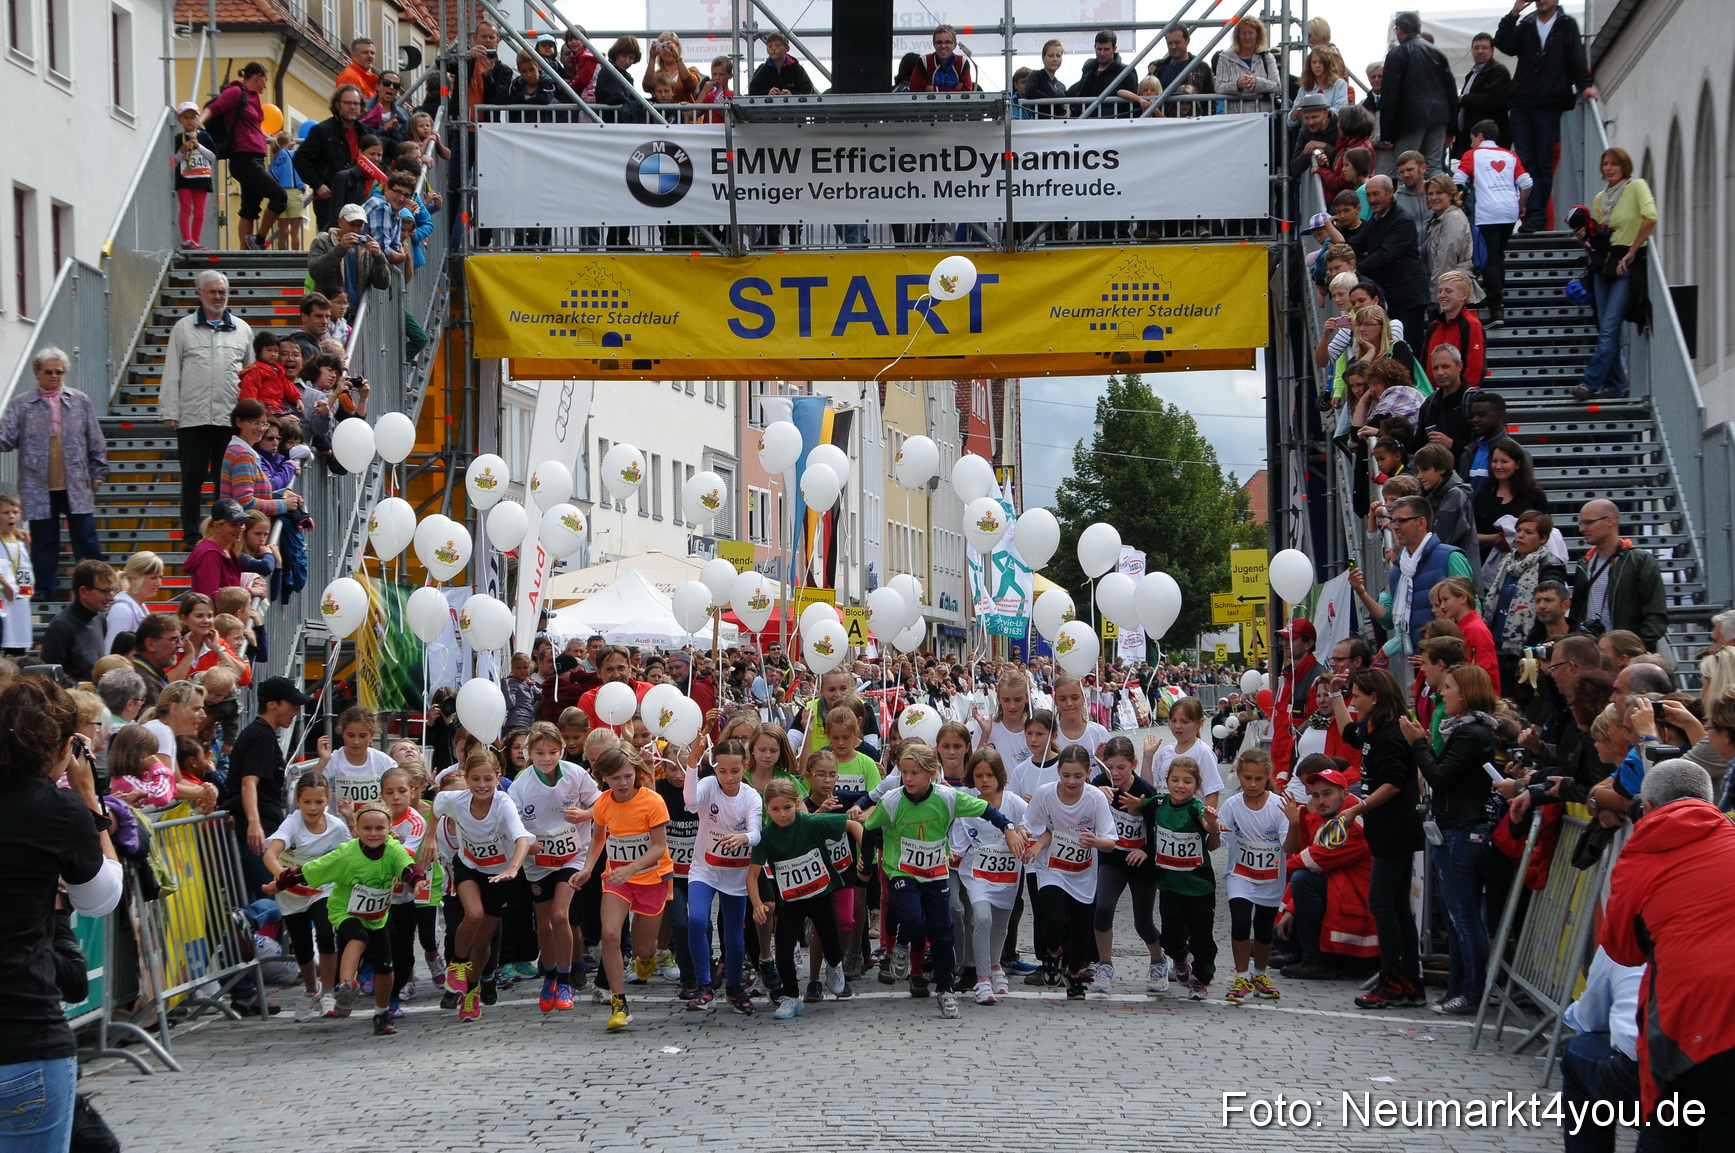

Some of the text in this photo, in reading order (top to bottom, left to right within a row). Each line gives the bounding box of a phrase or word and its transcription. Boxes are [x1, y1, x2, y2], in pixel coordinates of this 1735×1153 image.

[632, 141, 689, 164] BMW
[711, 143, 1121, 178] BMW EfficientDynamics
[712, 178, 1122, 205] Weniger Verbrauch. Mehr Fahrfreude.
[727, 273, 1000, 341] START
[1049, 302, 1222, 320] Neumarkter Stadtlauf
[509, 310, 681, 326] Neumarkter Stadtlauf
[1233, 564, 1267, 575] Jugend-
[1242, 575, 1259, 584] lauf
[848, 619, 862, 639] A
[1106, 621, 1115, 633] B
[1245, 619, 1267, 628] Bock
[1217, 647, 1225, 658] C
[341, 784, 378, 801] 7003
[1115, 821, 1143, 839] 394
[538, 836, 577, 856] 7285
[1056, 843, 1092, 863] 7280
[1160, 838, 1197, 858] 7182
[905, 848, 942, 867] 7017
[979, 853, 1016, 872] 7335
[1239, 847, 1275, 868] 7012
[780, 860, 822, 888] 7019
